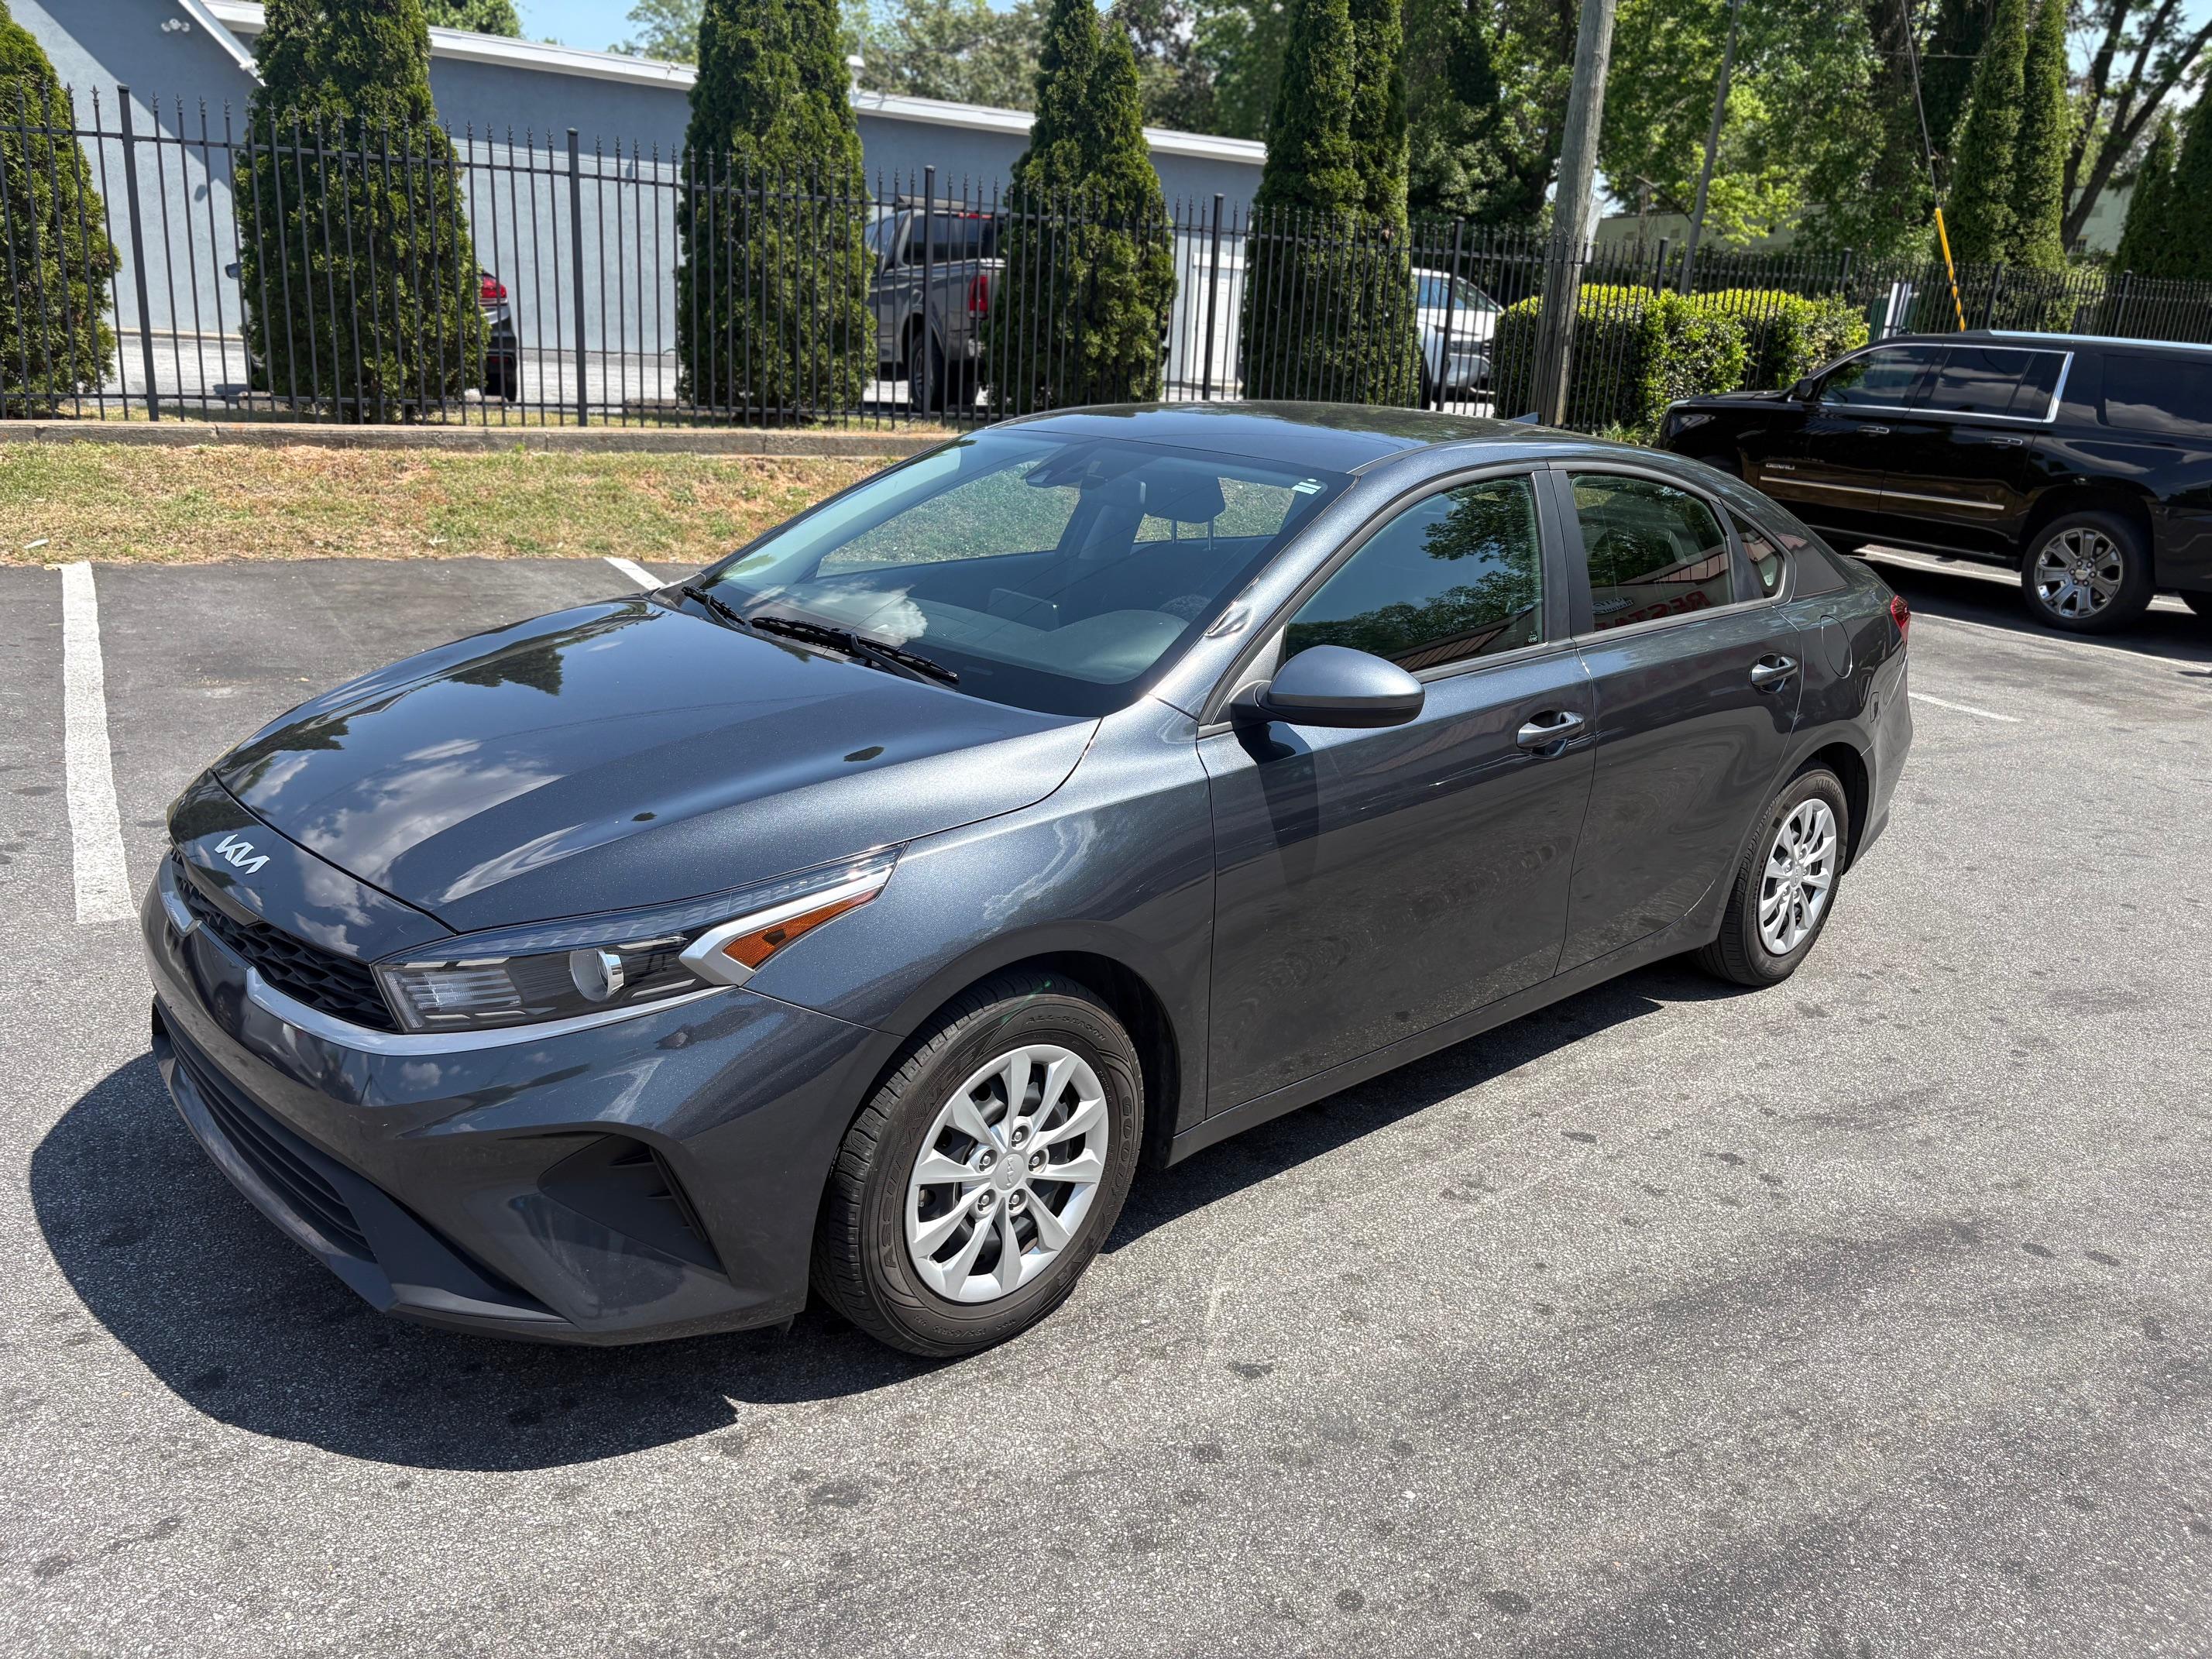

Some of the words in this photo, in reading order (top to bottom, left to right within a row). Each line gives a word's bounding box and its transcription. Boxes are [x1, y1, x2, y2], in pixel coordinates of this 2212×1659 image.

[1815, 778, 1842, 802] KUMHO
[215, 834, 270, 874] KIA
[1025, 1015, 1107, 1041] ALL-SEASON
